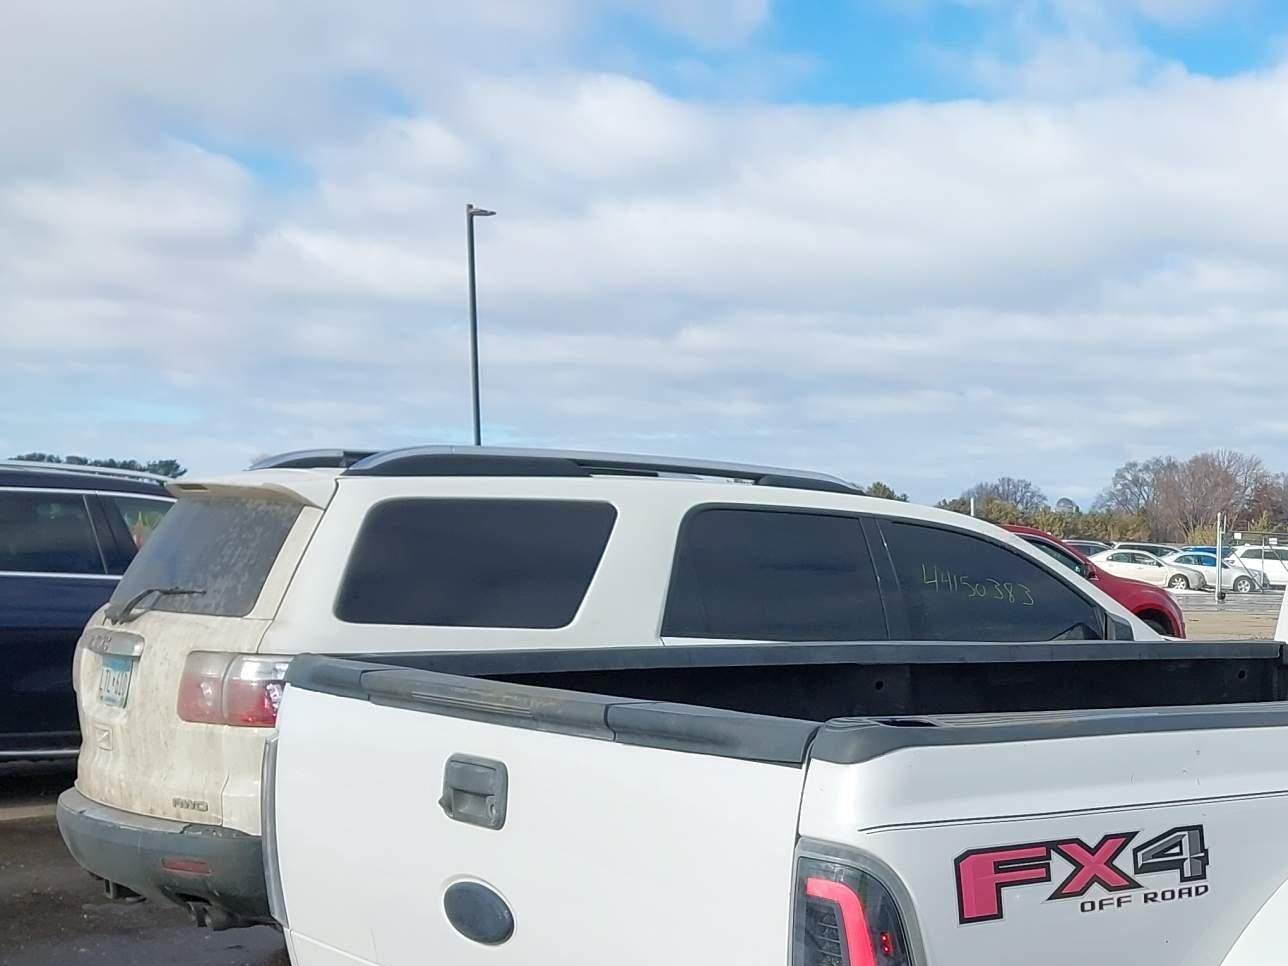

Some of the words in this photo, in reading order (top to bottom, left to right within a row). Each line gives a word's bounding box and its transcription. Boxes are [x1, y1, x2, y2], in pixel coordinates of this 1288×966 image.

[922, 563, 1034, 605] 44150383
[953, 824, 1209, 924] FX4
[1080, 895, 1132, 913] OFF
[1143, 885, 1209, 904] ROAD
